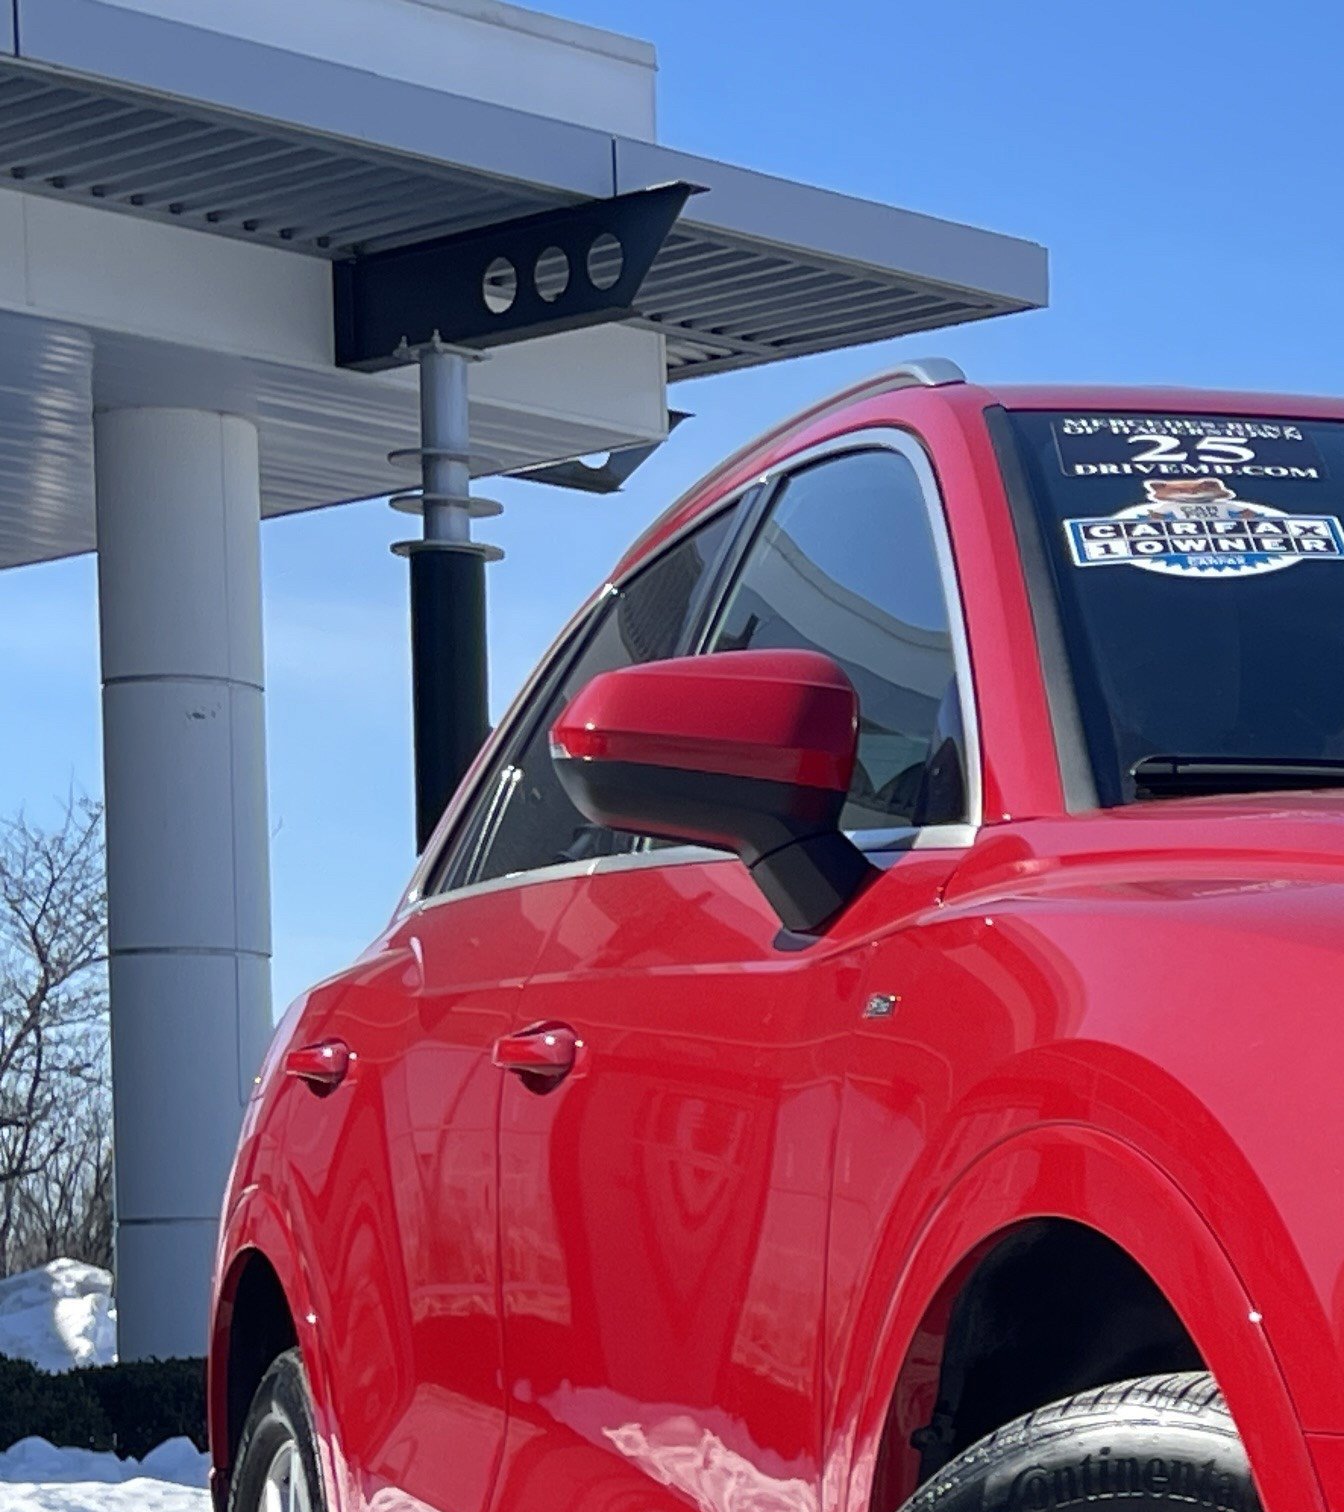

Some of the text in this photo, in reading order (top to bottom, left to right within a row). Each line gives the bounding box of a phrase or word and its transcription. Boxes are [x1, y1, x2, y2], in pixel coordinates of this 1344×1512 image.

[1127, 434, 1256, 463] 25
[1074, 463, 1320, 479] DRIVEMB.COM
[1089, 521, 1326, 538] CARFAX
[1135, 538, 1328, 554] OWNER
